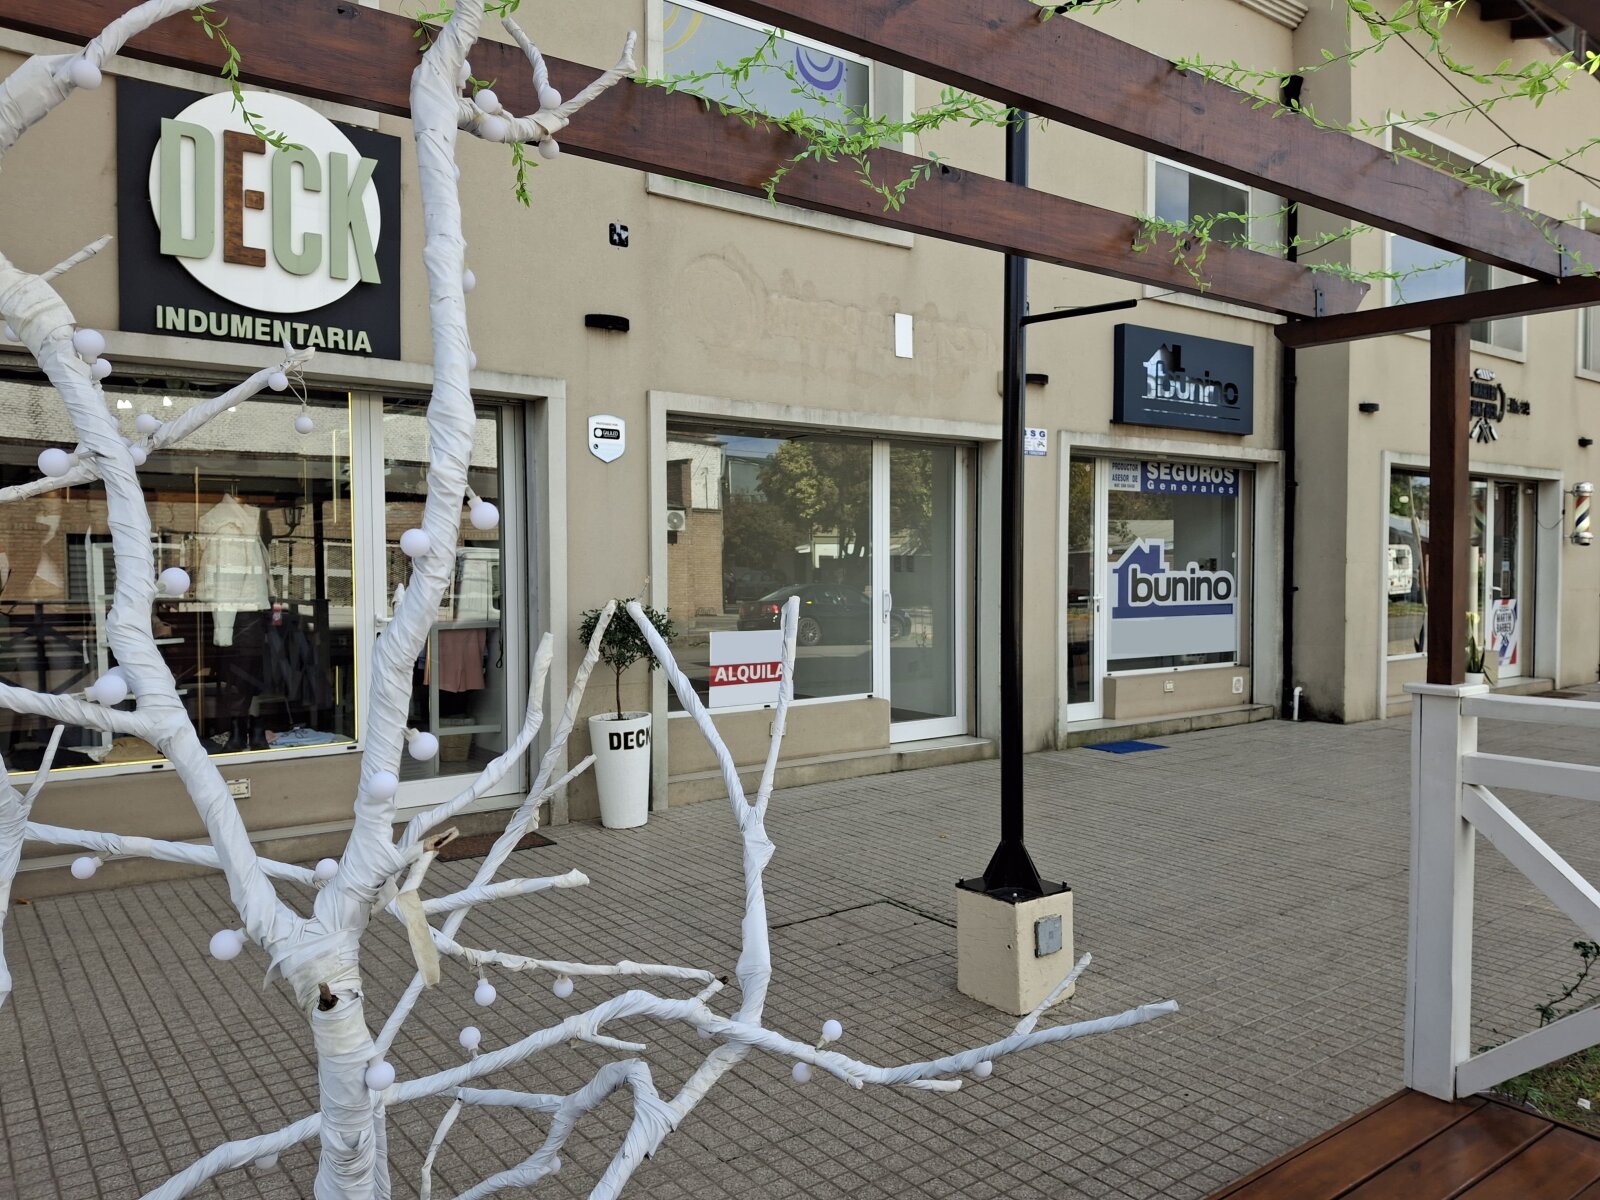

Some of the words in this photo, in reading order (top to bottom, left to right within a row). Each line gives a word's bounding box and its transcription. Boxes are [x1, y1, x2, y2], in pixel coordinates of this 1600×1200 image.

[160, 117, 381, 284] DECK
[156, 304, 372, 353] INDUMENTARIA
[1146, 462, 1235, 485] SEGUROS
[1147, 480, 1234, 494] Generales
[1131, 567, 1232, 603] bunino
